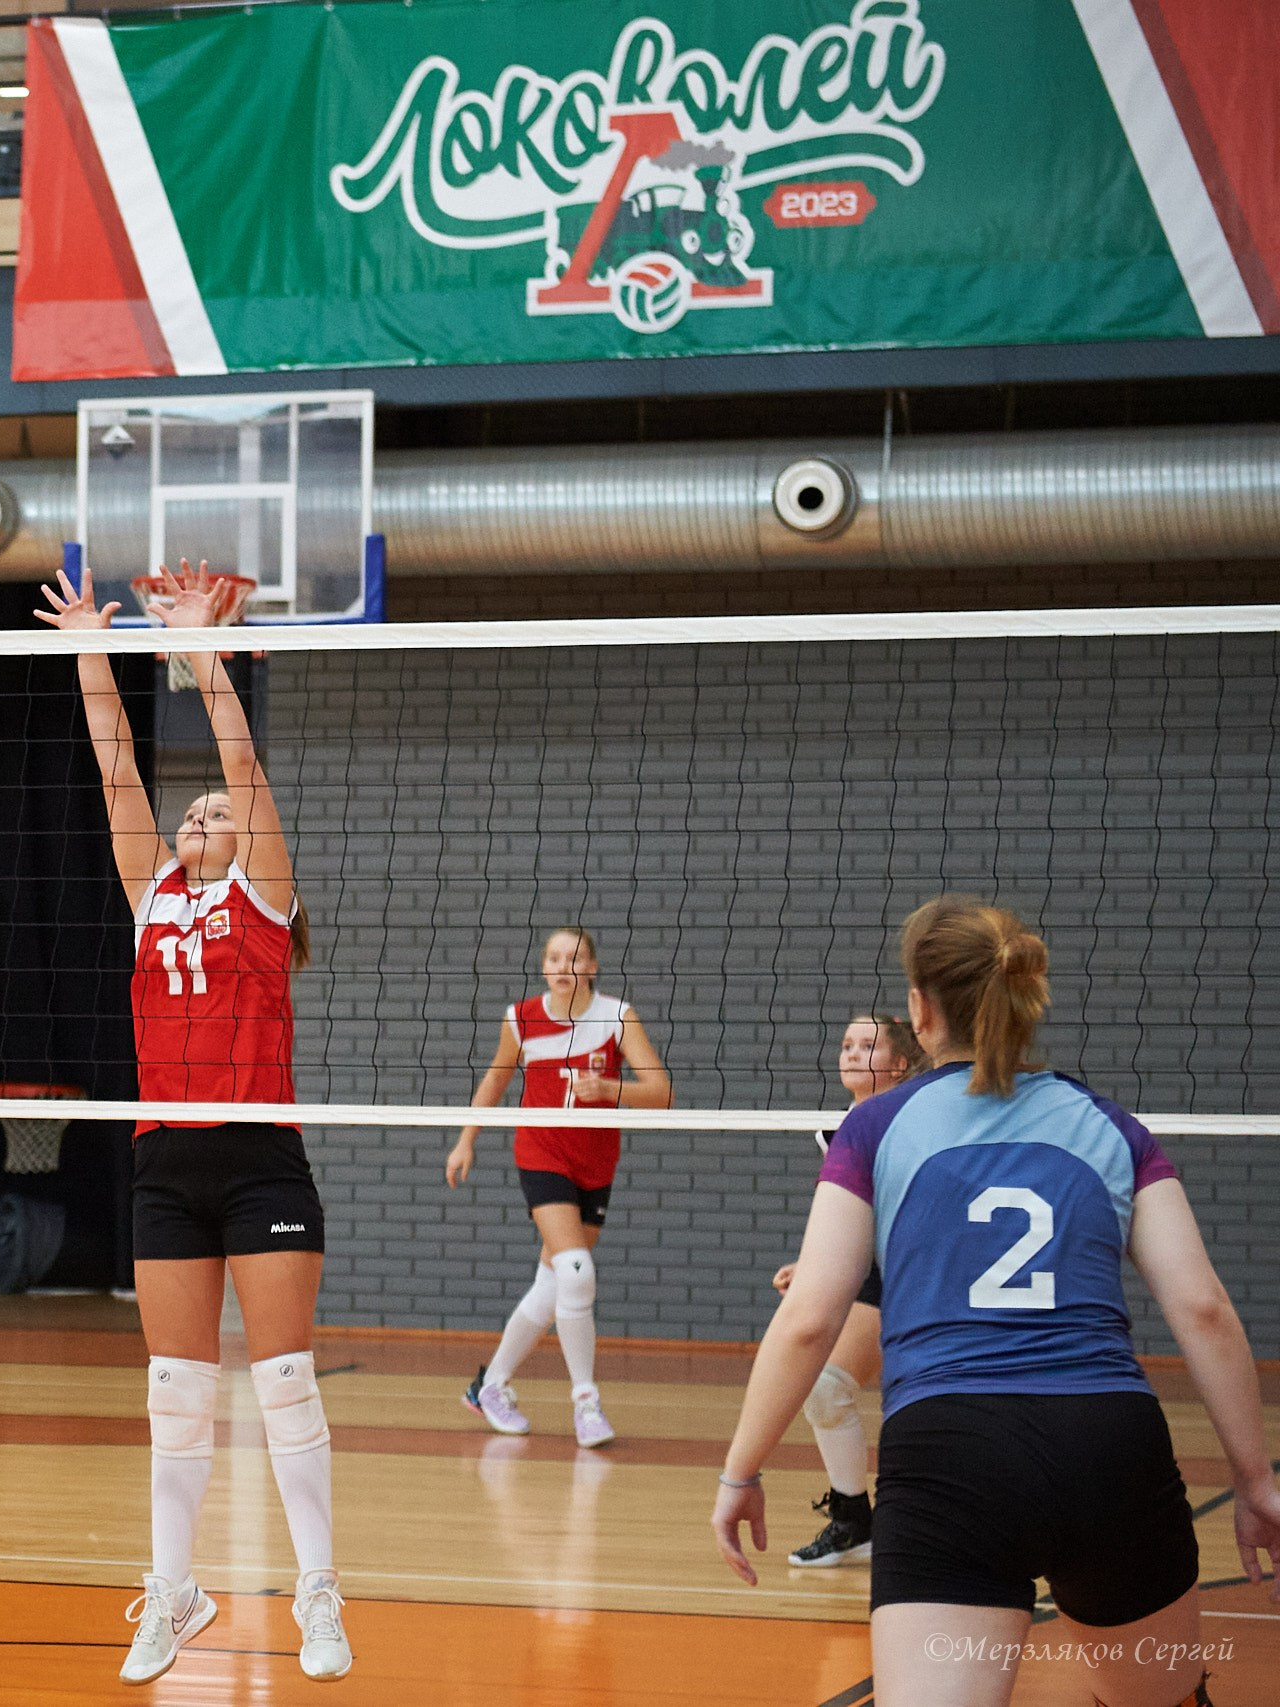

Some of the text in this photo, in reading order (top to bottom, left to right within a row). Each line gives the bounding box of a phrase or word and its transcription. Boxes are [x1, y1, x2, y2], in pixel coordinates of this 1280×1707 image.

[781, 190, 858, 219] 2023
[156, 930, 207, 995] 11
[967, 1186, 1055, 1309] 2
